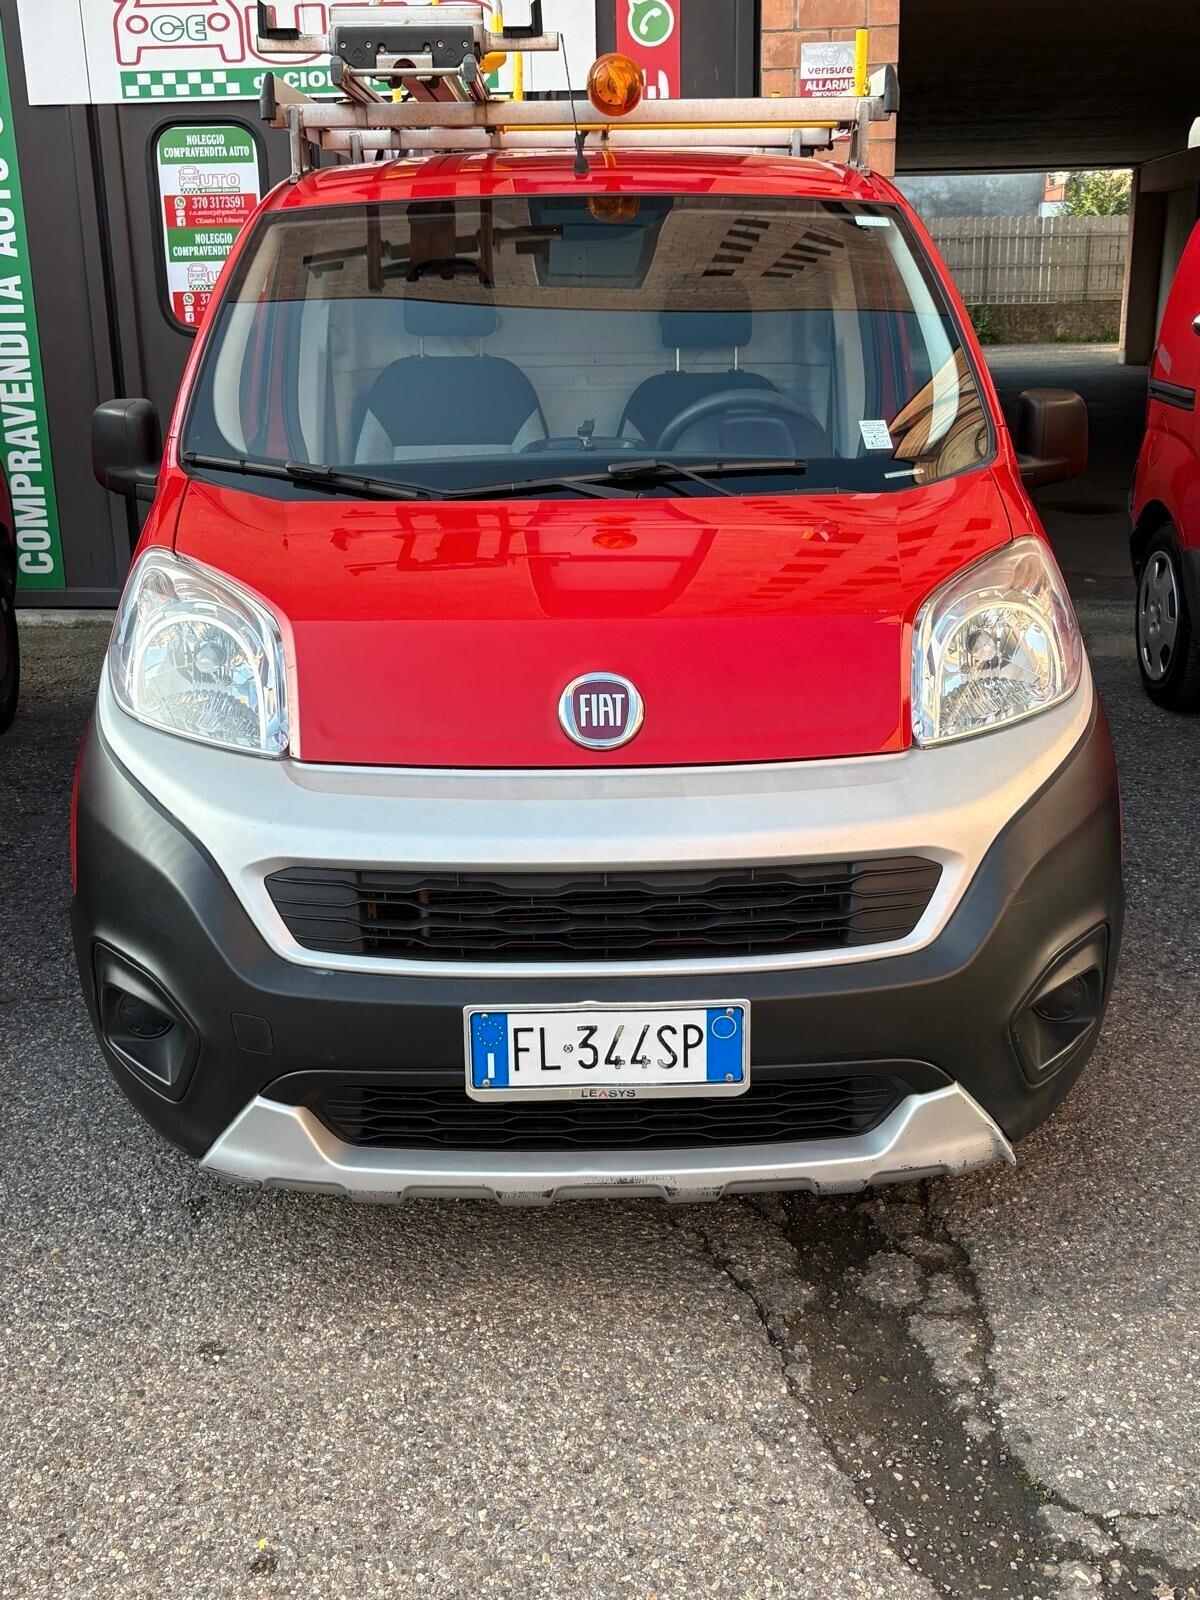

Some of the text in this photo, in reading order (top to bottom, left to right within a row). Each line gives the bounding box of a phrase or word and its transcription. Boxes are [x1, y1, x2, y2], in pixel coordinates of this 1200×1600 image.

[151, 15, 207, 42] CE
[808, 66, 853, 75] verisure
[186, 134, 225, 145] NOLEGGIO
[163, 145, 250, 158] COMPRAVENDITA AUTO
[192, 196, 245, 209] 370 3173591
[195, 233, 232, 244] NOLEGGIO
[173, 245, 232, 257] COMPRAVENDIT
[0, 275, 54, 574] COMPRAVENDITA
[579, 693, 625, 727] FIAT
[513, 1026, 561, 1072] FL
[577, 1024, 703, 1069] 344SP
[581, 1089, 636, 1098] LEASYS
